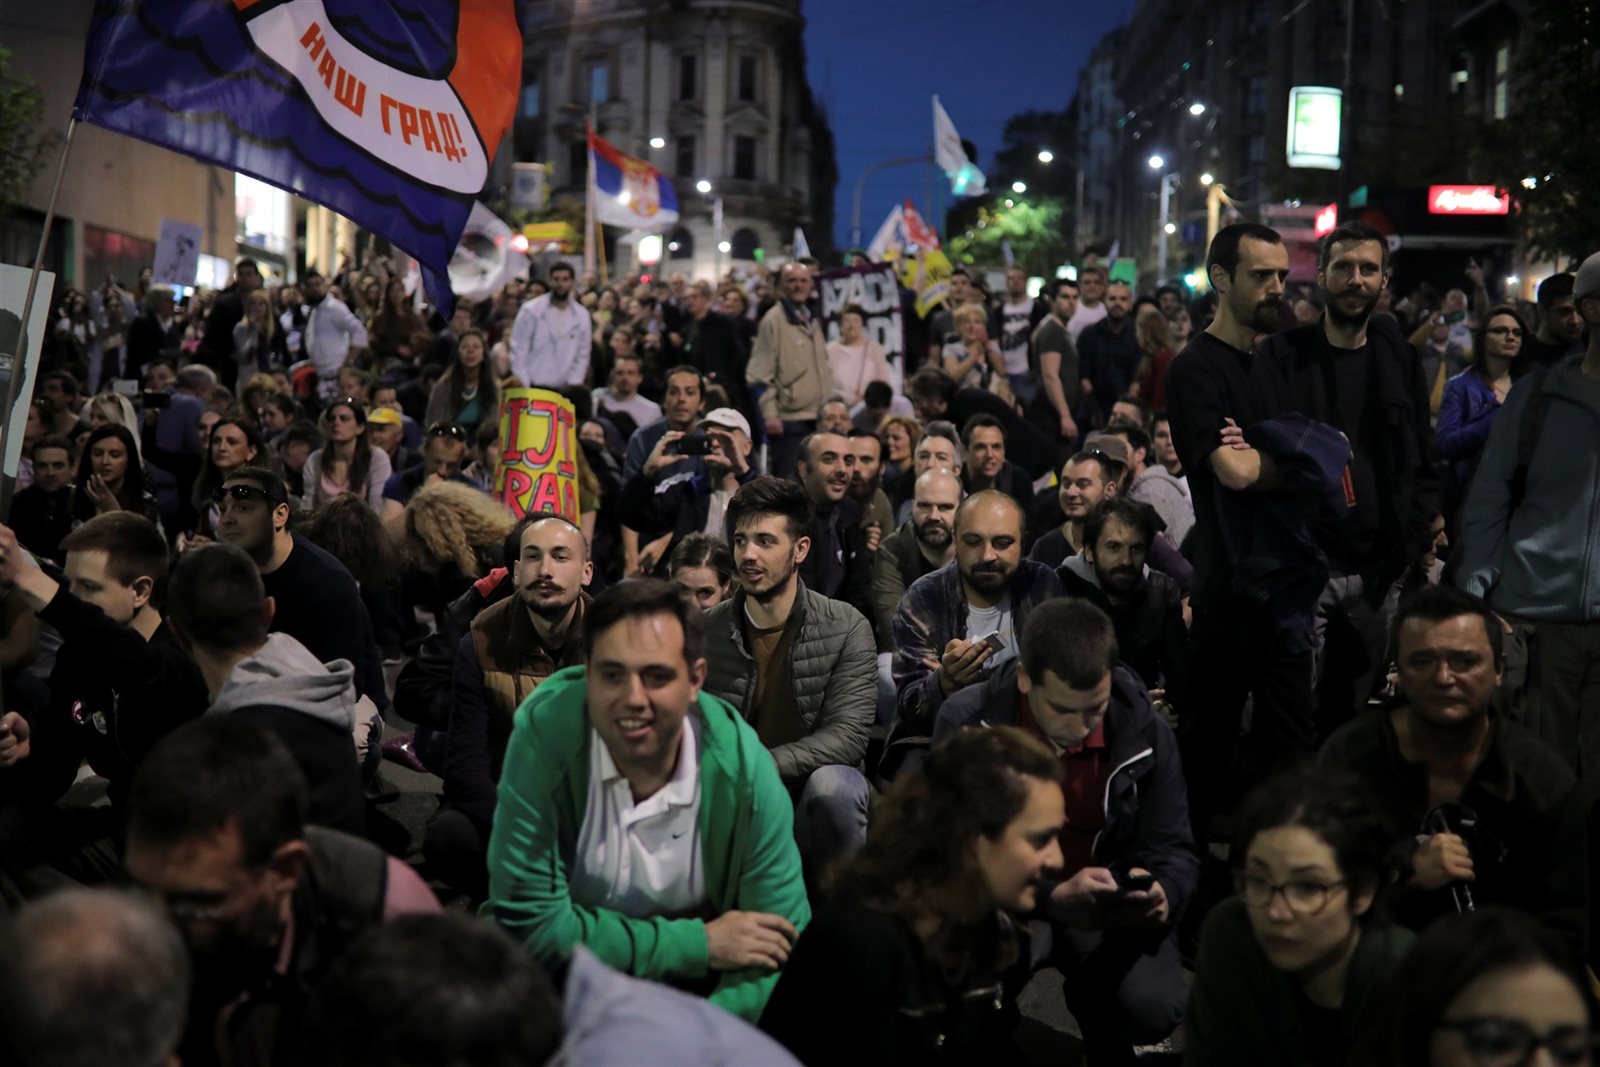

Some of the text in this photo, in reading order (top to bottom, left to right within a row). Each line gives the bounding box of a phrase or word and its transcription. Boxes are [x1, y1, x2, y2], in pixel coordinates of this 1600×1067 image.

[299, 21, 467, 163] НАШ ГРАД!
[499, 397, 575, 479] IJI
